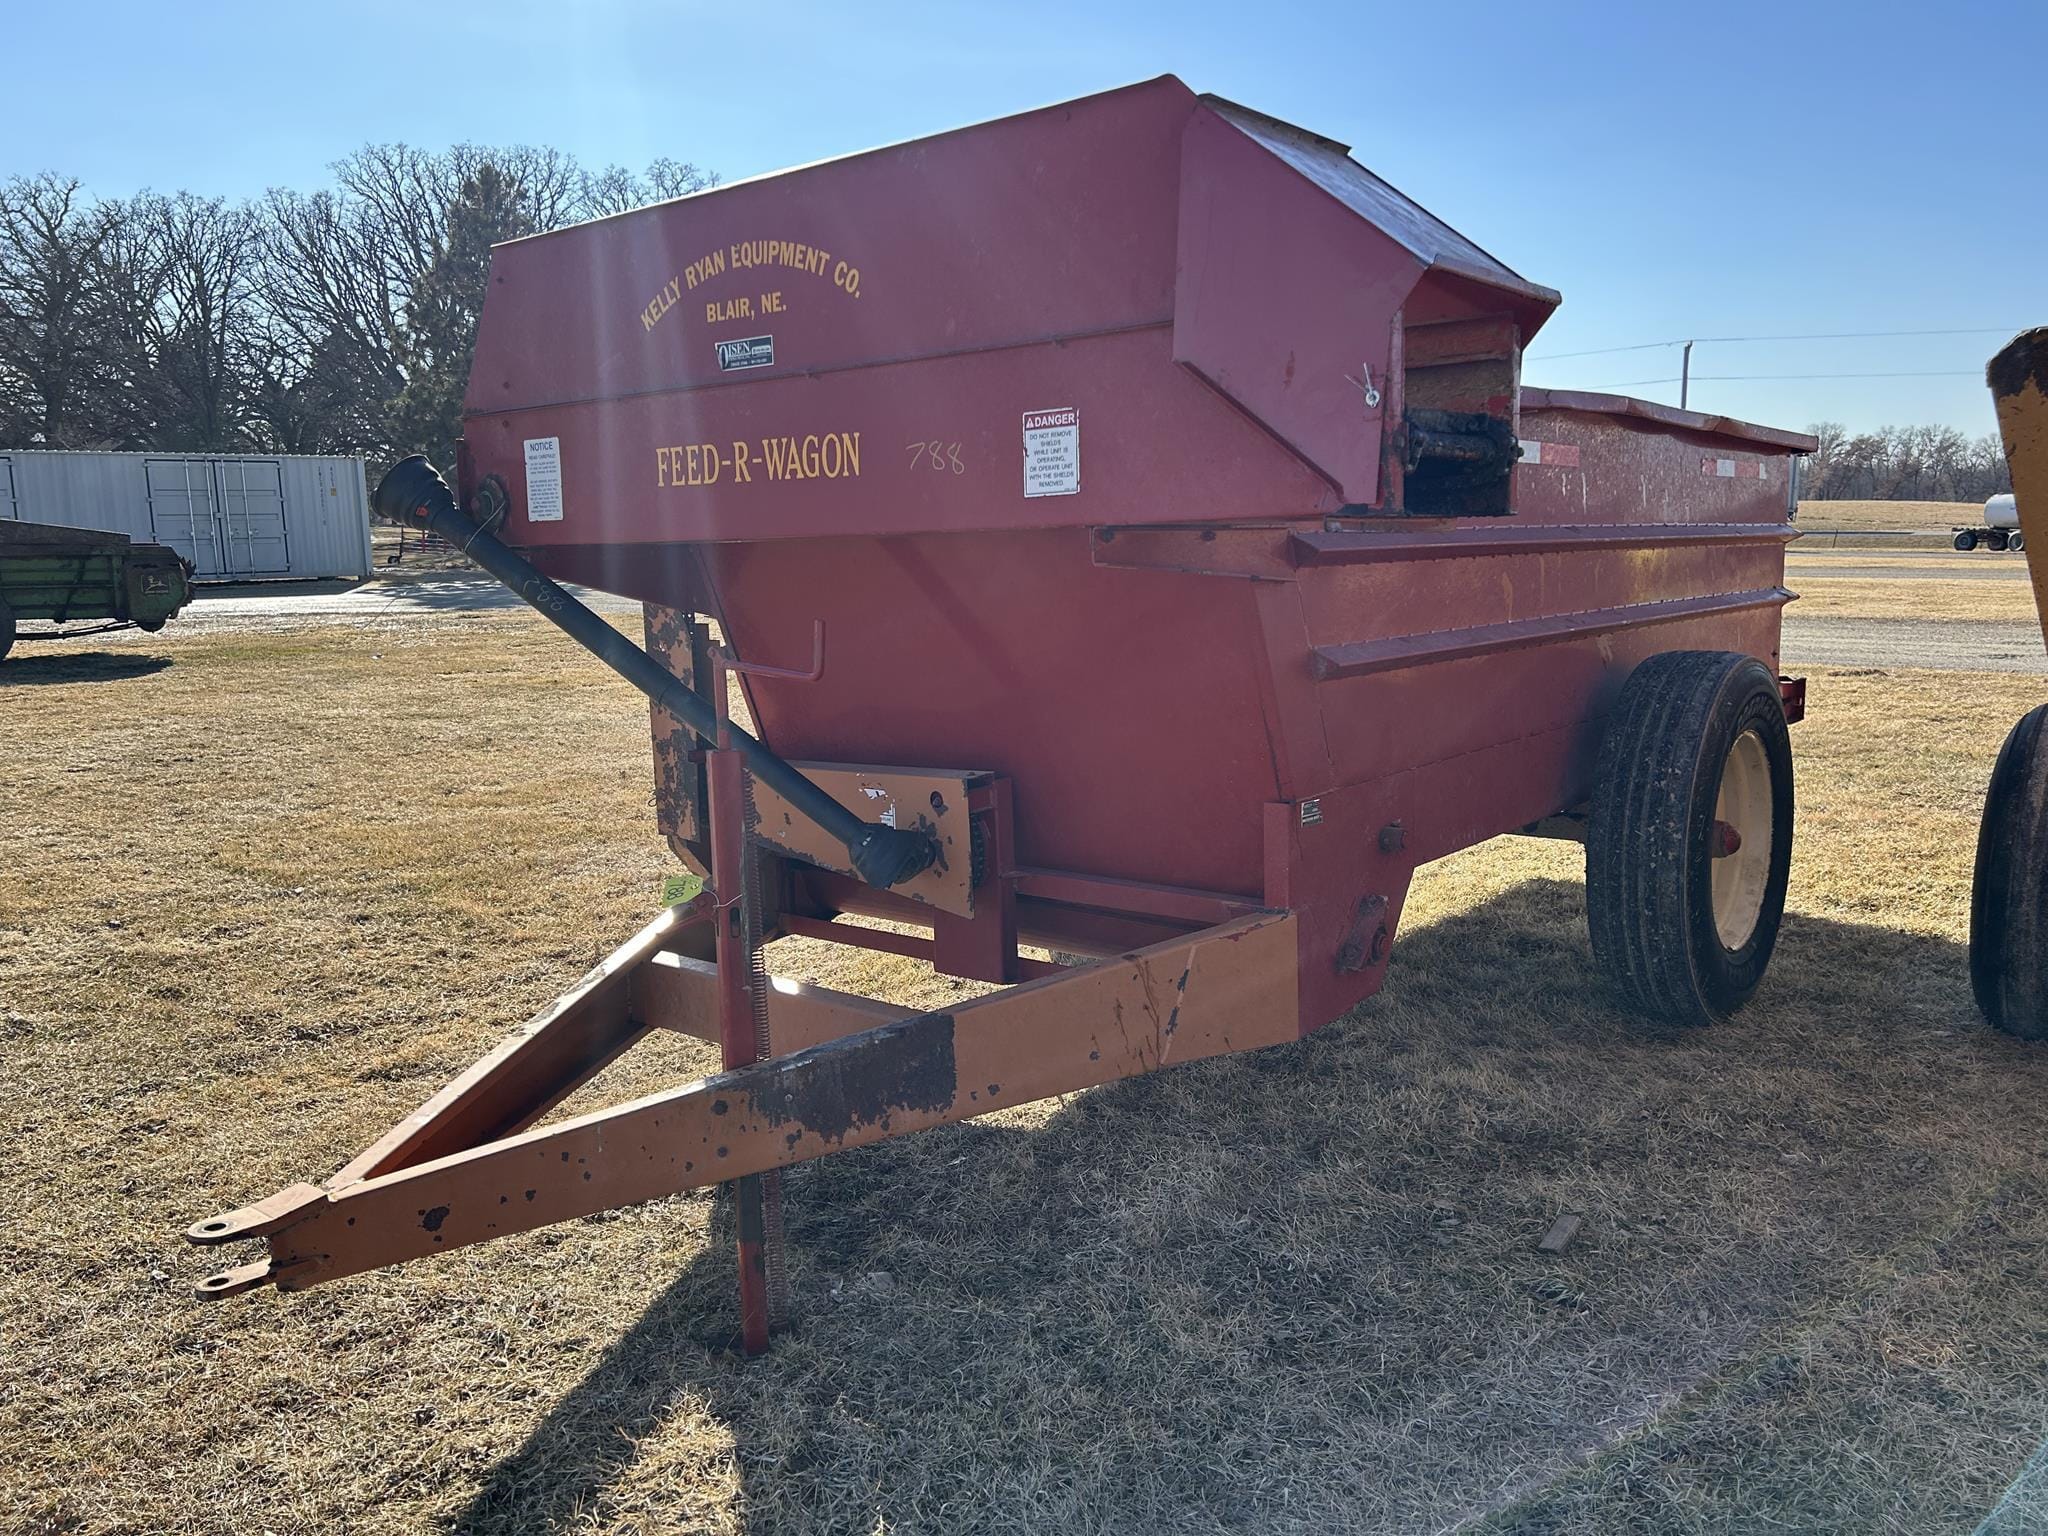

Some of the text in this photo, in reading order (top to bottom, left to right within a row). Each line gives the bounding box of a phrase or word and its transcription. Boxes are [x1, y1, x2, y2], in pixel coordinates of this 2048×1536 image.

[640, 240, 861, 332] KELLY RYAN EQUIPMENT CO.
[706, 291, 787, 323] BLAIR, NE.
[1034, 413, 1075, 427] DANGER
[529, 441, 553, 452] NOTICE
[1051, 430, 1072, 438] REMOVE
[655, 432, 860, 487] FEED-R-WAGON
[906, 440, 965, 475] 788
[667, 880, 687, 900] 788
